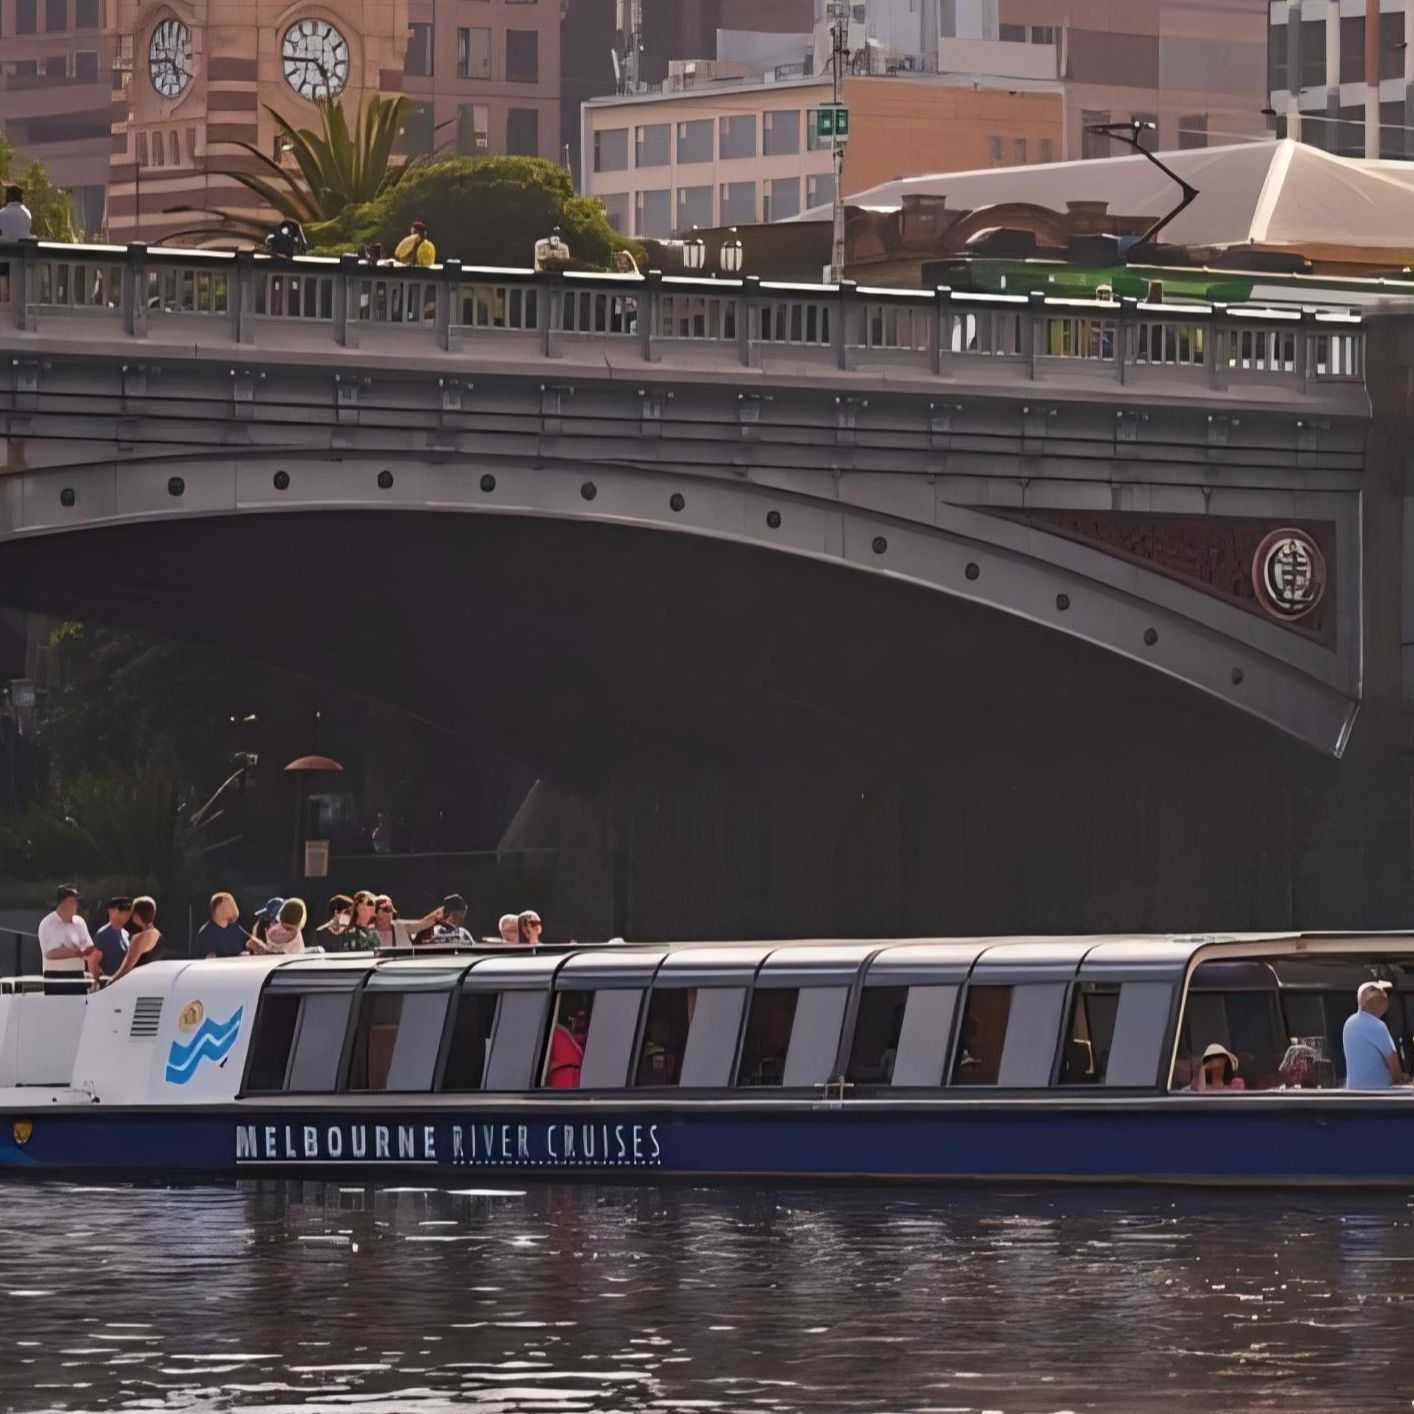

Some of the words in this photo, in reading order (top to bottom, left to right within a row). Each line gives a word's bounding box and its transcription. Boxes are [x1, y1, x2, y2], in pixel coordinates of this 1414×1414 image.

[236, 1125, 436, 1158] MELBOURNE
[453, 1125, 530, 1158] RIVER
[548, 1125, 660, 1158] CRUISES
